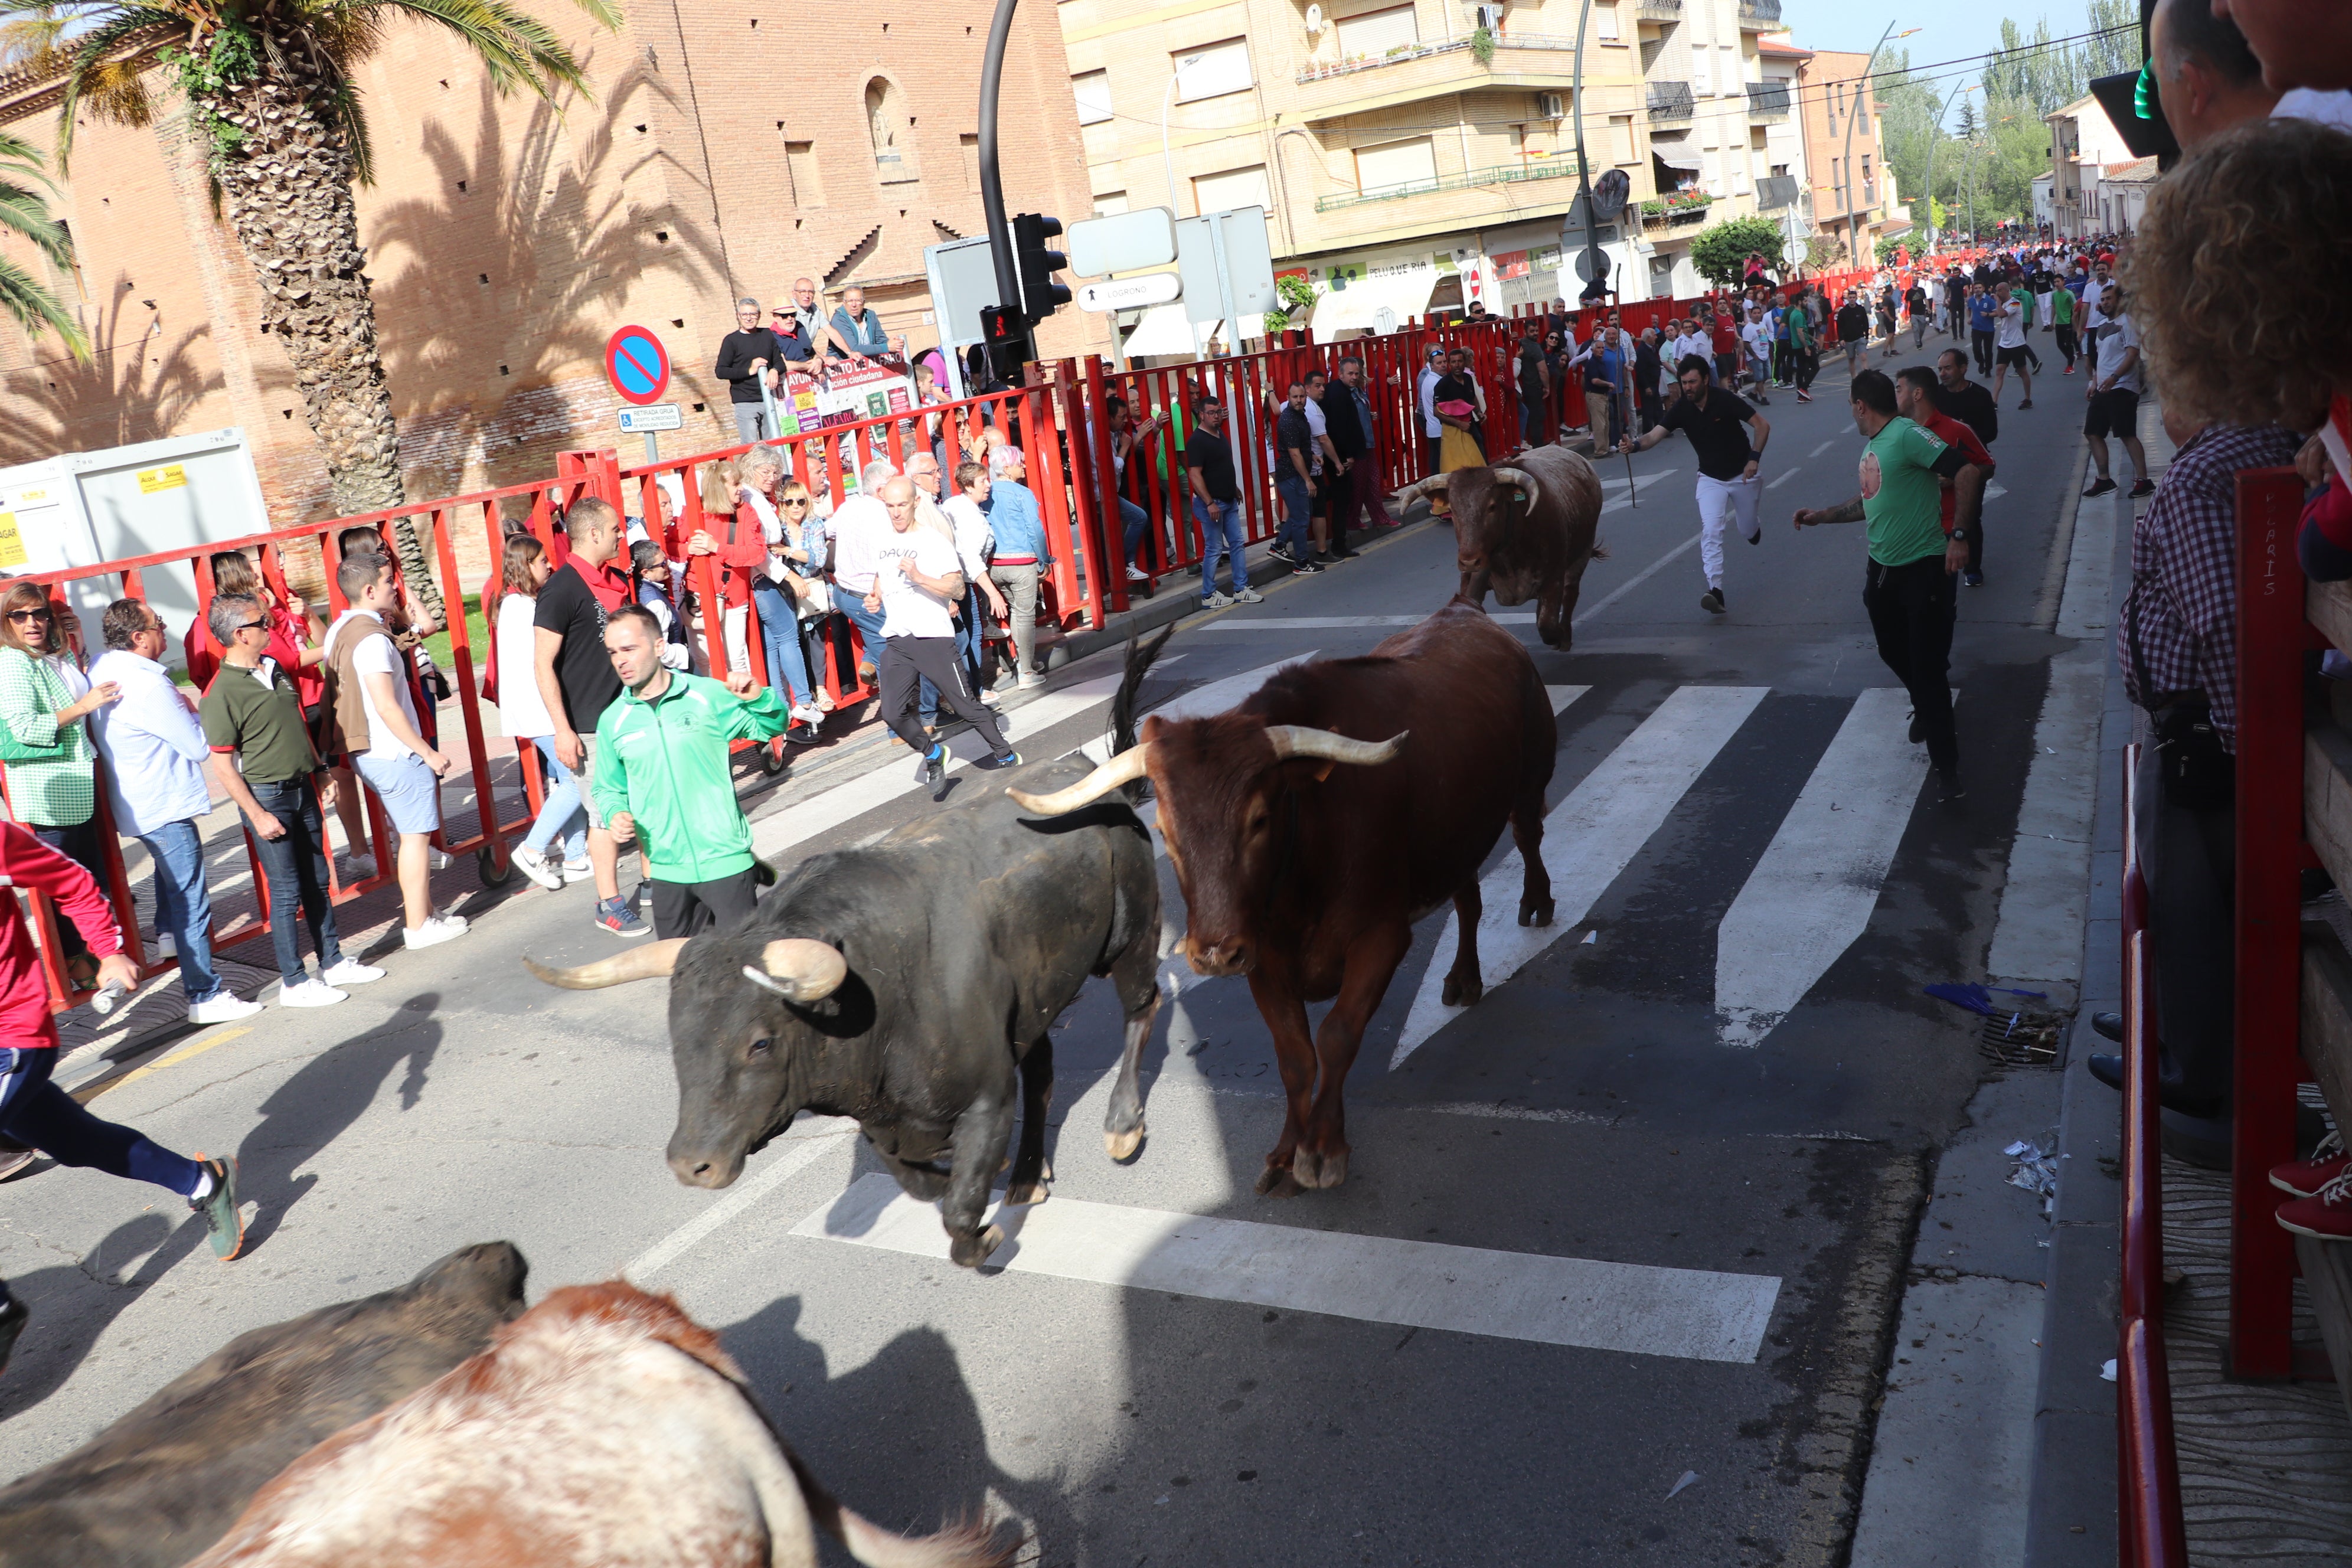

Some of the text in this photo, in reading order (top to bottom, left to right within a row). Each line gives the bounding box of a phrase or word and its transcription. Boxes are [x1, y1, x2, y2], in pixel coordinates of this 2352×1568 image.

[854, 359, 867, 373] DE
[868, 352, 902, 370] ALFARO
[848, 371, 883, 385] ciudadana
[822, 411, 857, 428] ALFARO
[879, 548, 918, 560] DAVID
